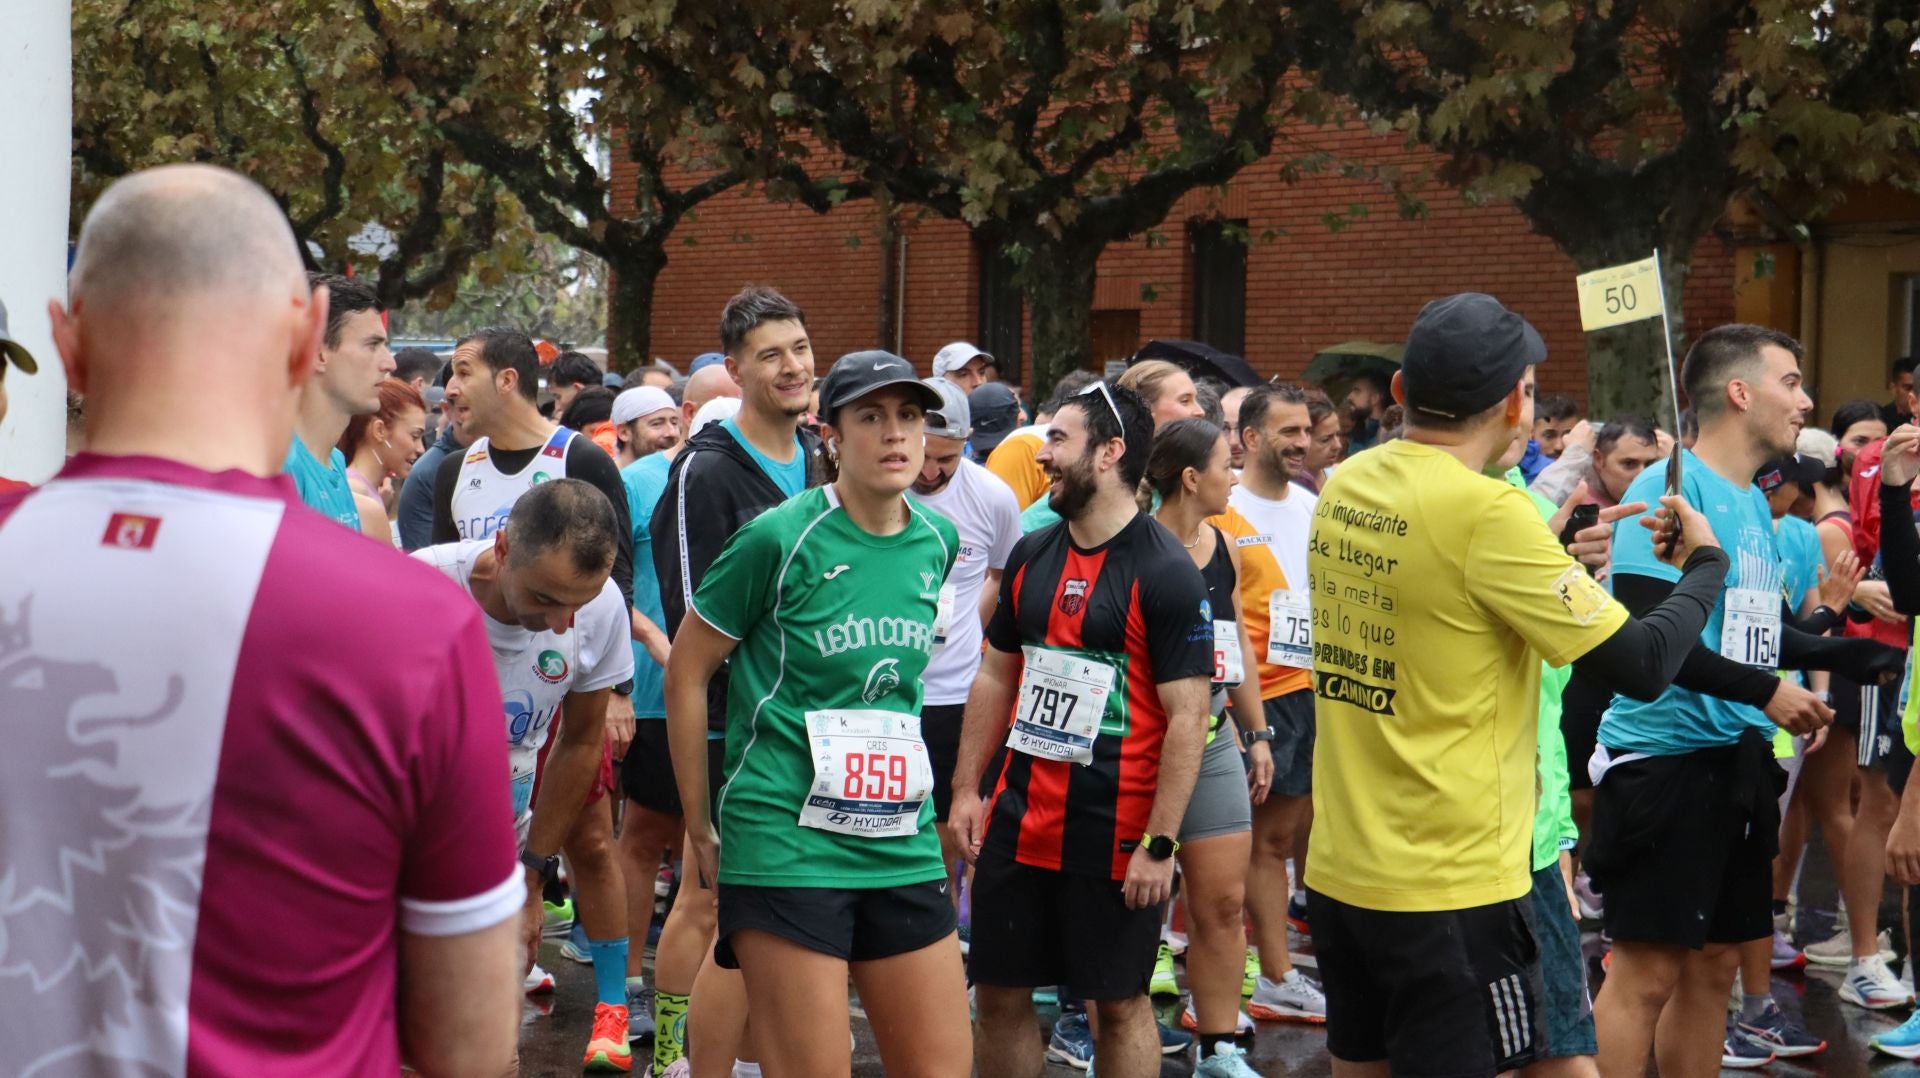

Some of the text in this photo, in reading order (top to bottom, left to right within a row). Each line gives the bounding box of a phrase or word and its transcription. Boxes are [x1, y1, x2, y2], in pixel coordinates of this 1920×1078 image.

[1605, 284, 1637, 314] 50
[1332, 500, 1408, 537] importante
[1238, 536, 1272, 545] WACKER
[1309, 530, 1399, 577] de llegar
[1310, 571, 1394, 611] a la meta
[1312, 603, 1396, 649] es lo que
[1745, 625, 1777, 665] 1154
[1083, 666, 1090, 675] k
[1372, 658, 1396, 681] EN
[1031, 684, 1078, 730] 797
[1325, 676, 1388, 711] CAMINO
[840, 716, 847, 727] k
[900, 719, 907, 730] k
[866, 740, 888, 751] CRIS
[1030, 737, 1074, 756] HYUNDAI
[843, 752, 907, 801] 859
[853, 815, 902, 828] HYUNDAI
